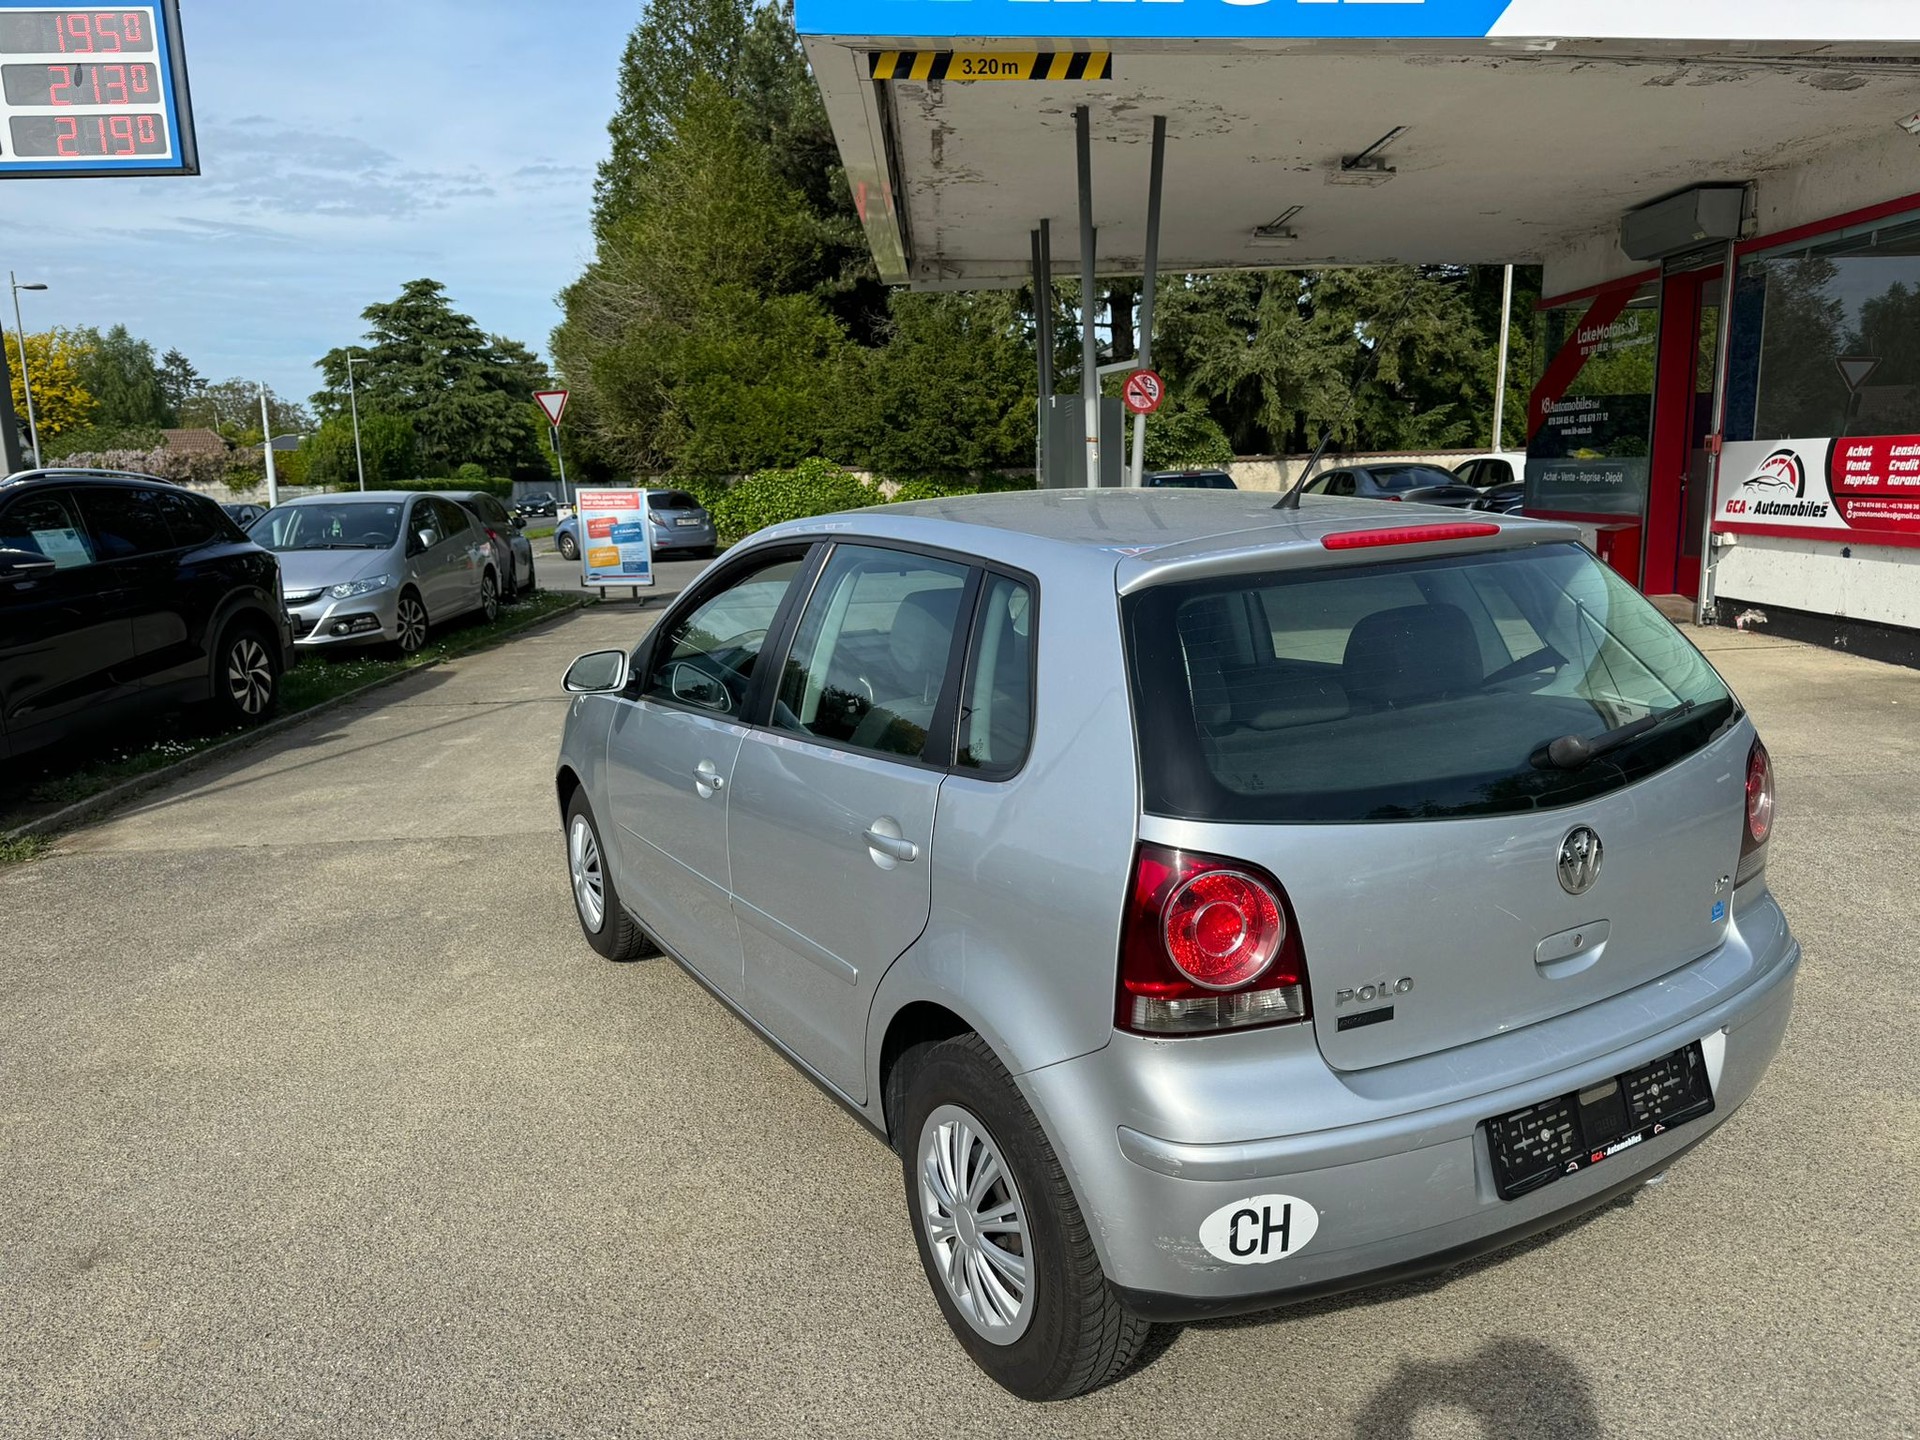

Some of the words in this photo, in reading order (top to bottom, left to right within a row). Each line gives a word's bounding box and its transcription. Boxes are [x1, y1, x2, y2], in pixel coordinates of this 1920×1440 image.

[962, 58, 998, 75] 3.20
[1002, 61, 1018, 75] m
[1049, 395, 1056, 408] 1
[1846, 445, 1873, 457] Achat
[1846, 460, 1872, 471] Vente
[1888, 459, 1919, 471] Credit
[1542, 472, 1558, 482] Achat
[1561, 472, 1576, 482] Vente
[1579, 472, 1601, 484] Reprise
[1605, 471, 1623, 484] Dépôt
[1844, 473, 1879, 487] Reprise
[1725, 500, 1747, 514] GCA
[1753, 500, 1828, 518] Automobiles
[1335, 976, 1415, 1008] POLO
[1606, 1132, 1643, 1156] Automobiles
[1229, 1203, 1290, 1256] CH
